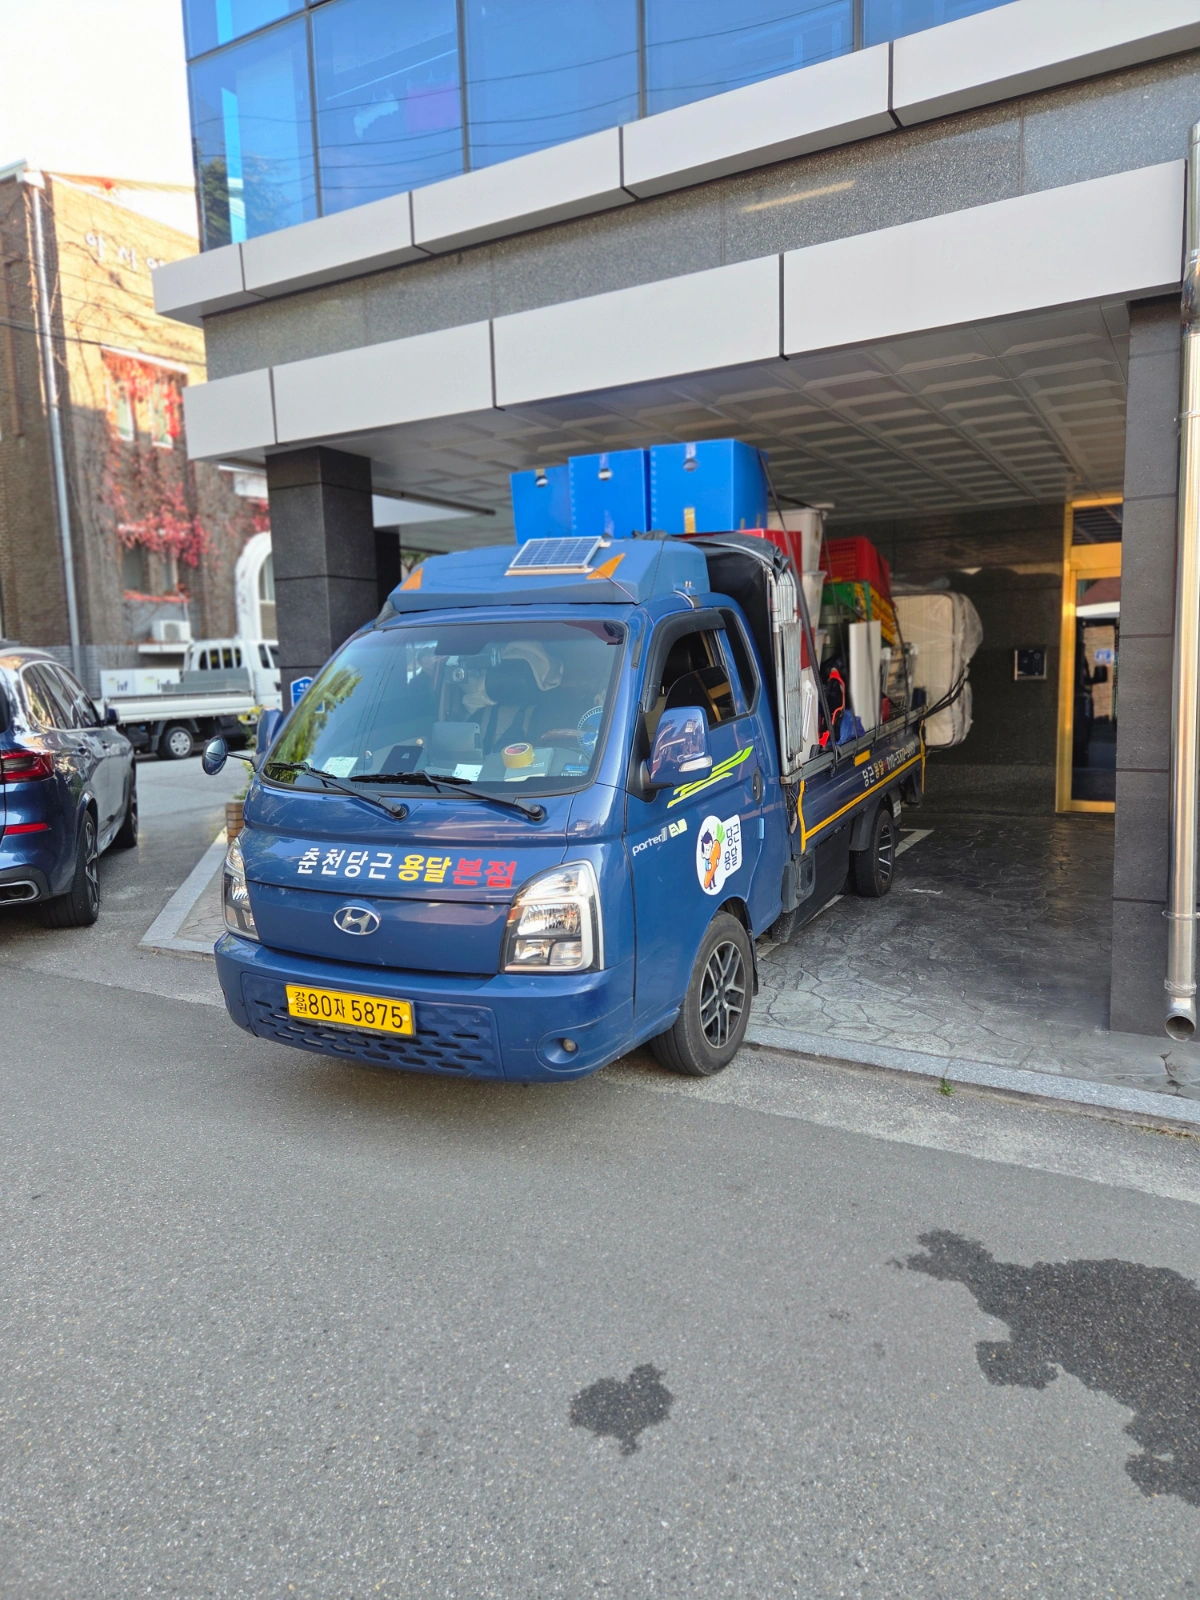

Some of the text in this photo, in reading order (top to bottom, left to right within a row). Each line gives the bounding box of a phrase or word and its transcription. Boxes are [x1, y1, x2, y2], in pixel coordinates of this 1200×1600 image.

[725, 823, 740, 847] 당근
[297, 847, 517, 888] 춘천당근 용달 본점
[723, 845, 738, 871] 용달
[308, 993, 346, 1018] 80자
[351, 999, 403, 1029] 5875
